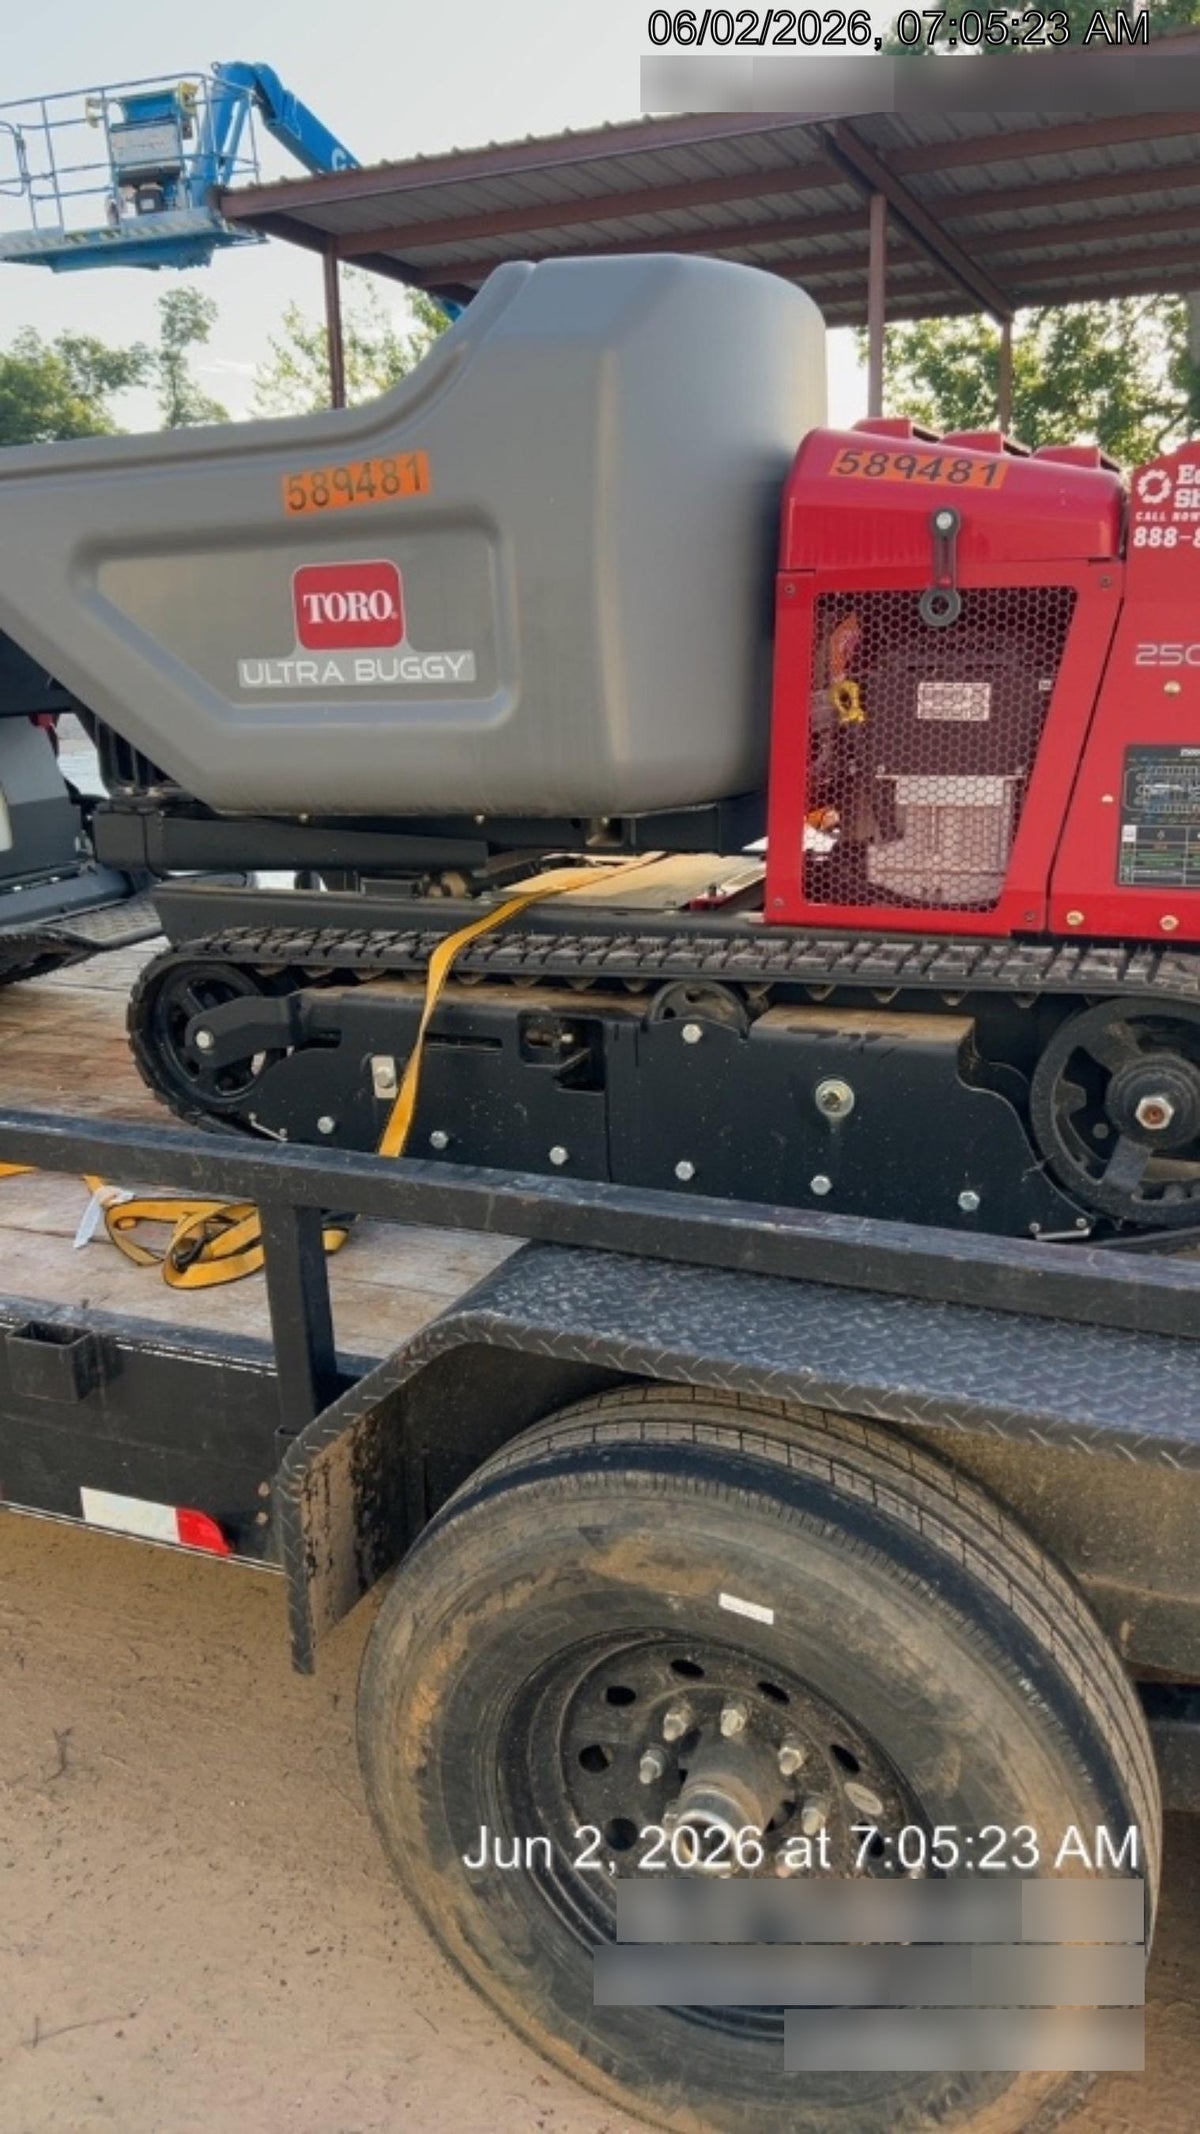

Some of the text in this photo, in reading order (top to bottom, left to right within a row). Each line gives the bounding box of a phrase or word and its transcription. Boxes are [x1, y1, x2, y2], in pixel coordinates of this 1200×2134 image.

[286, 453, 422, 512] 589481
[836, 449, 999, 487] 589481
[1135, 511, 1166, 522] CALL
[303, 590, 393, 624] TORO
[242, 655, 468, 685] ULTRA BUGGY
